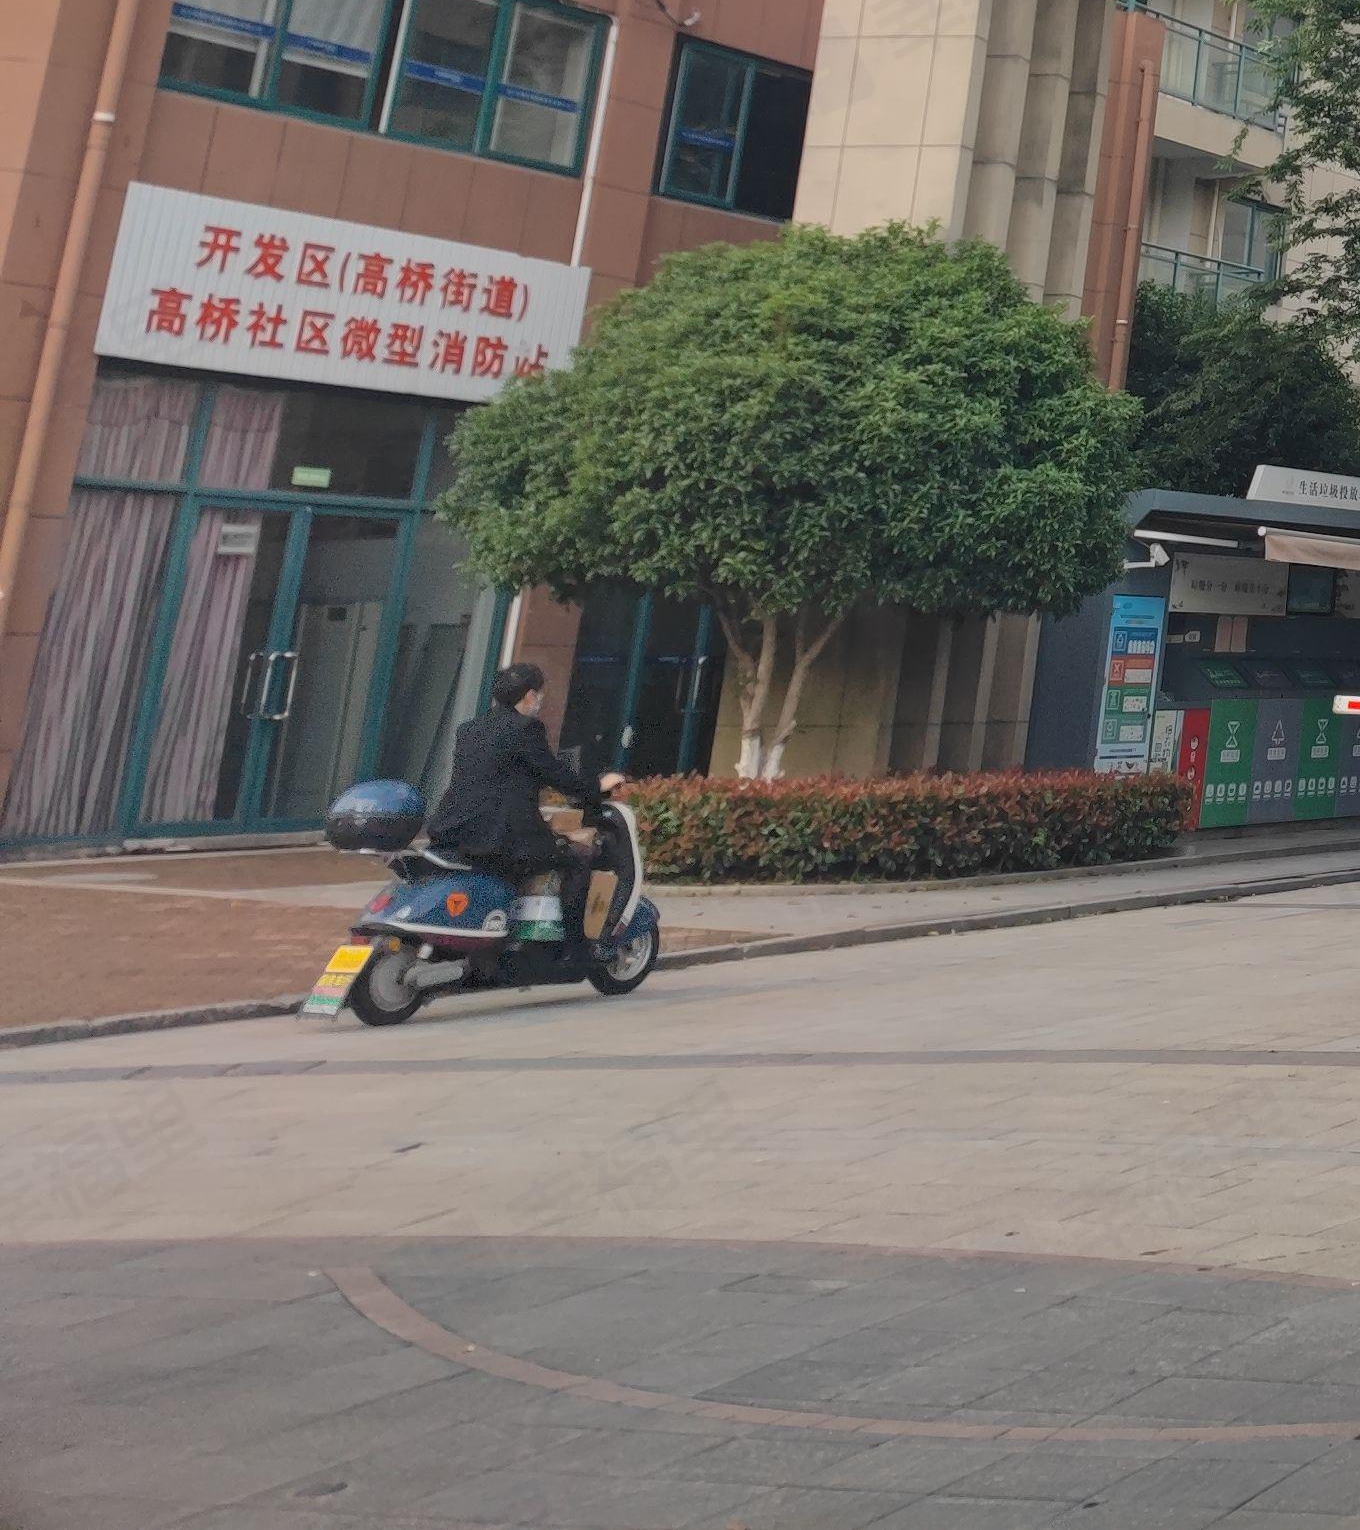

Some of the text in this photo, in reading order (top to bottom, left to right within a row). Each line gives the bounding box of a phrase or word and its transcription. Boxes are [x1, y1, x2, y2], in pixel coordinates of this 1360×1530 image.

[196, 224, 530, 323] 开发区(高桥街道)
